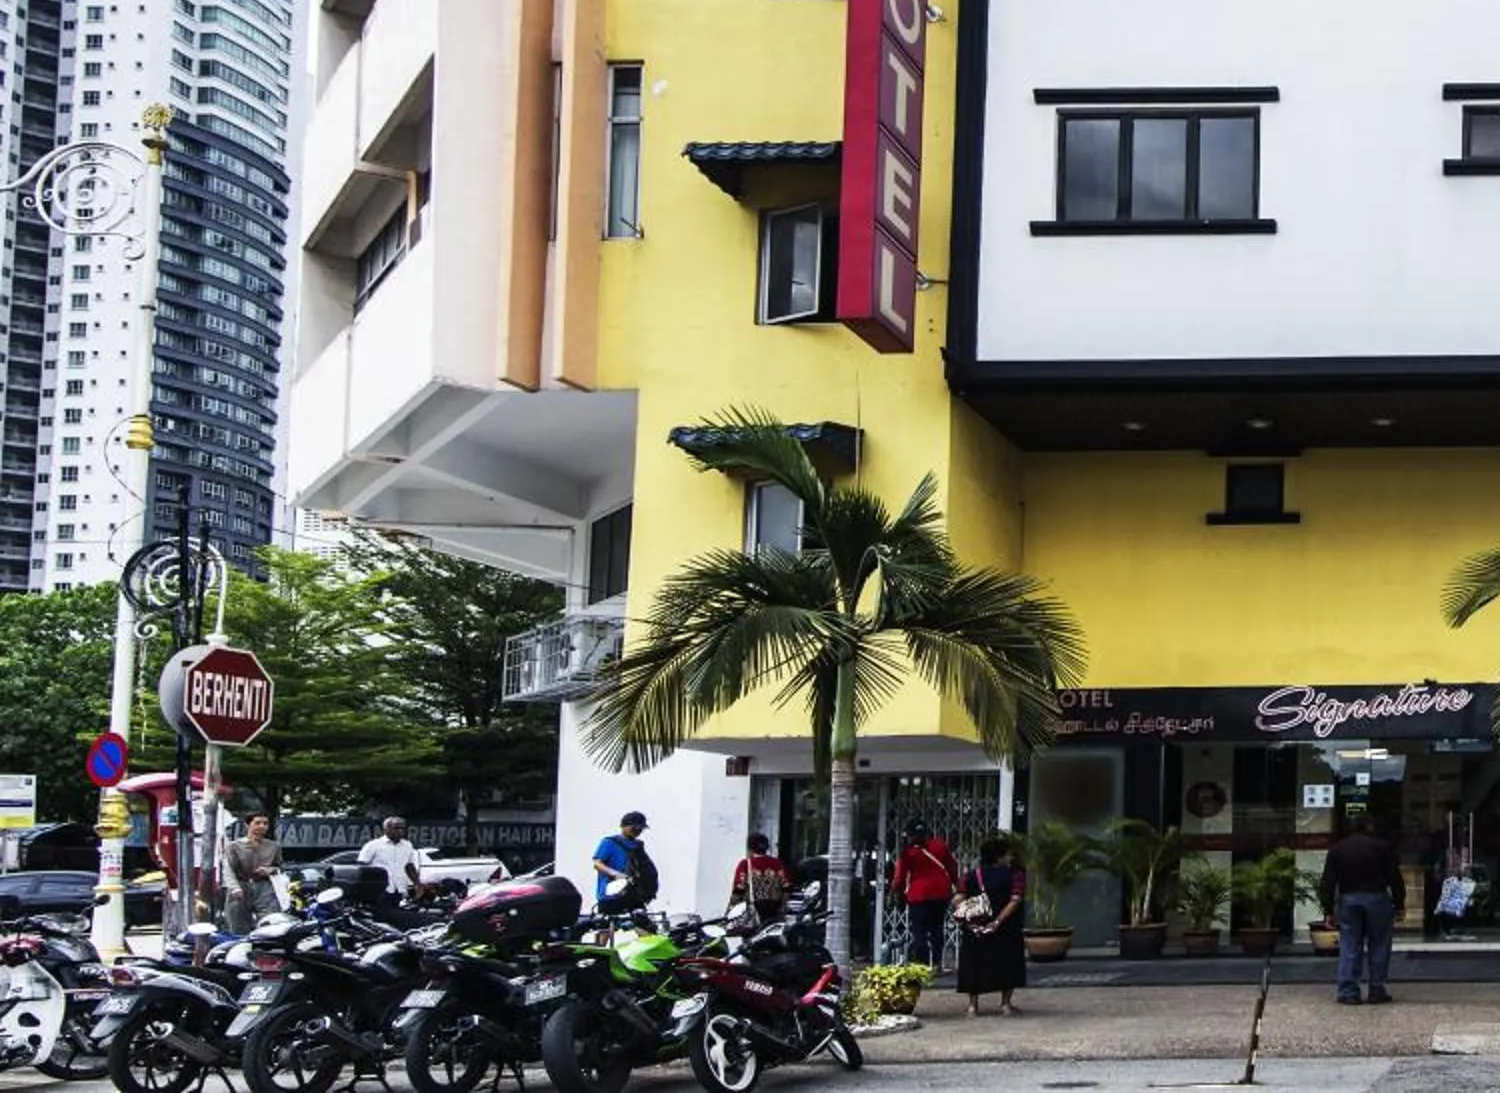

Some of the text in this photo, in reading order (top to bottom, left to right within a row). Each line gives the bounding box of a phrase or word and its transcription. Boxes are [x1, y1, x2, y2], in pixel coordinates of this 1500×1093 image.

[191, 670, 267, 722] BERHENTI
[1059, 690, 1114, 708] OTEL
[1256, 683, 1473, 738] Signature
